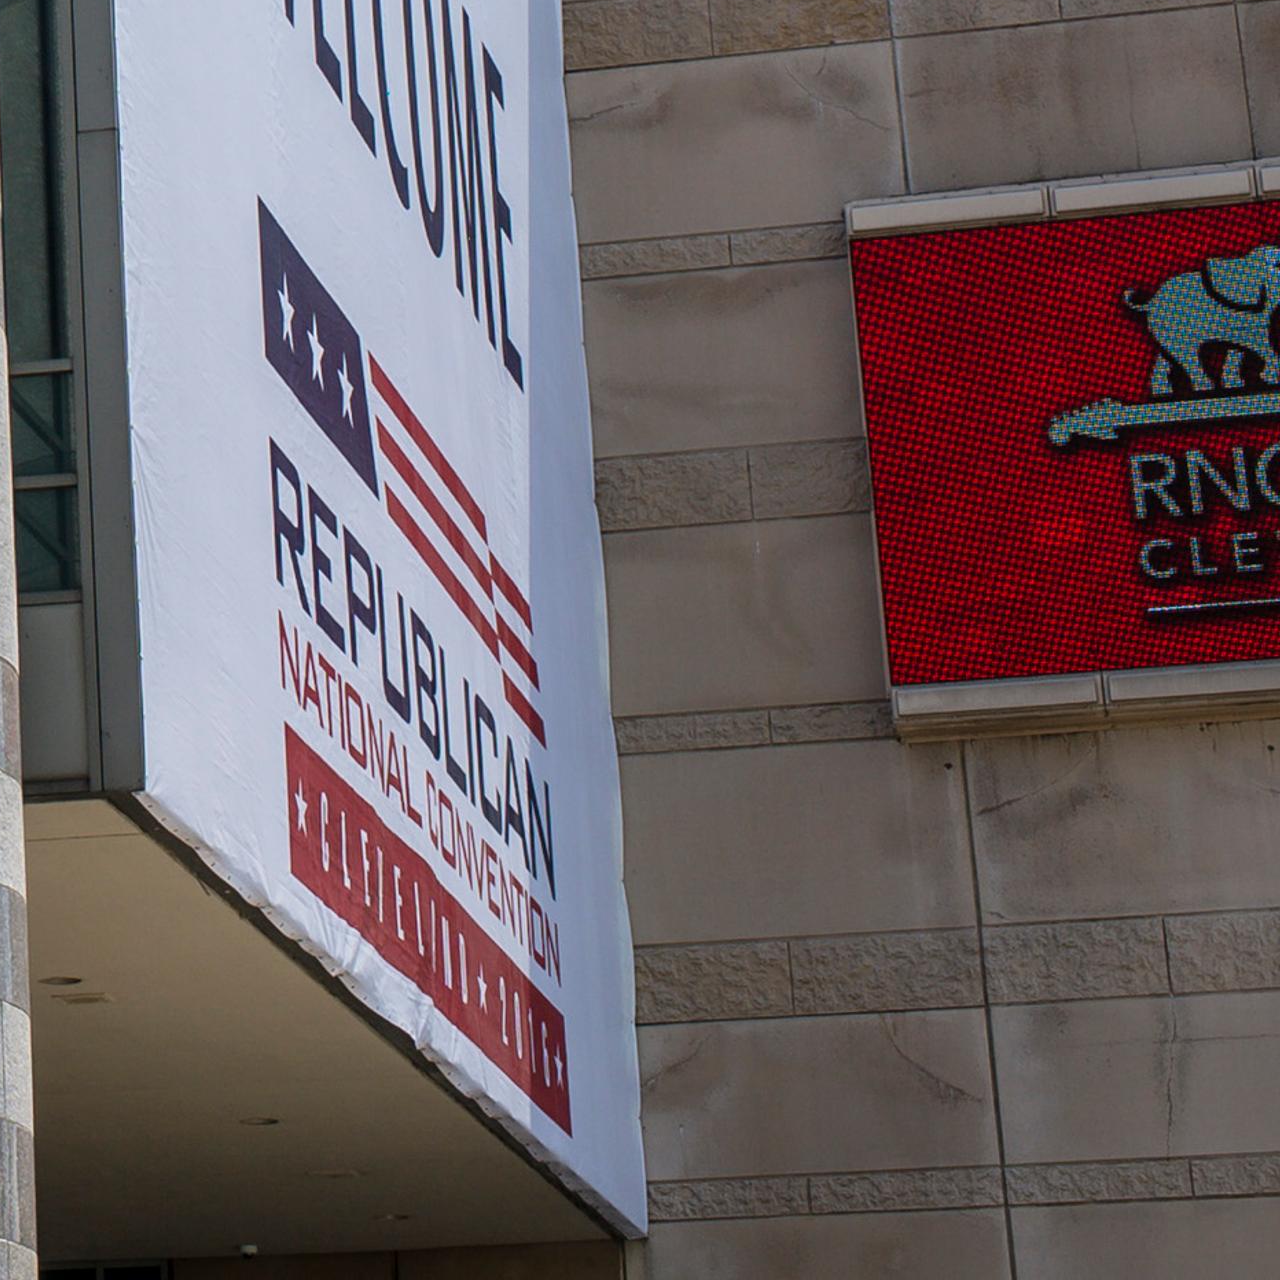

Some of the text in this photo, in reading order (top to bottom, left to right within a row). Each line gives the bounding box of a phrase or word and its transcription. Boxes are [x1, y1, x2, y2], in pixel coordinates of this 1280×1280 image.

[269, 435, 557, 902] REPUBLICAN
[1140, 530, 1280, 579] CLE
[278, 608, 563, 988] NATIONAL CONVENTION
[498, 976, 552, 1088] 2016
